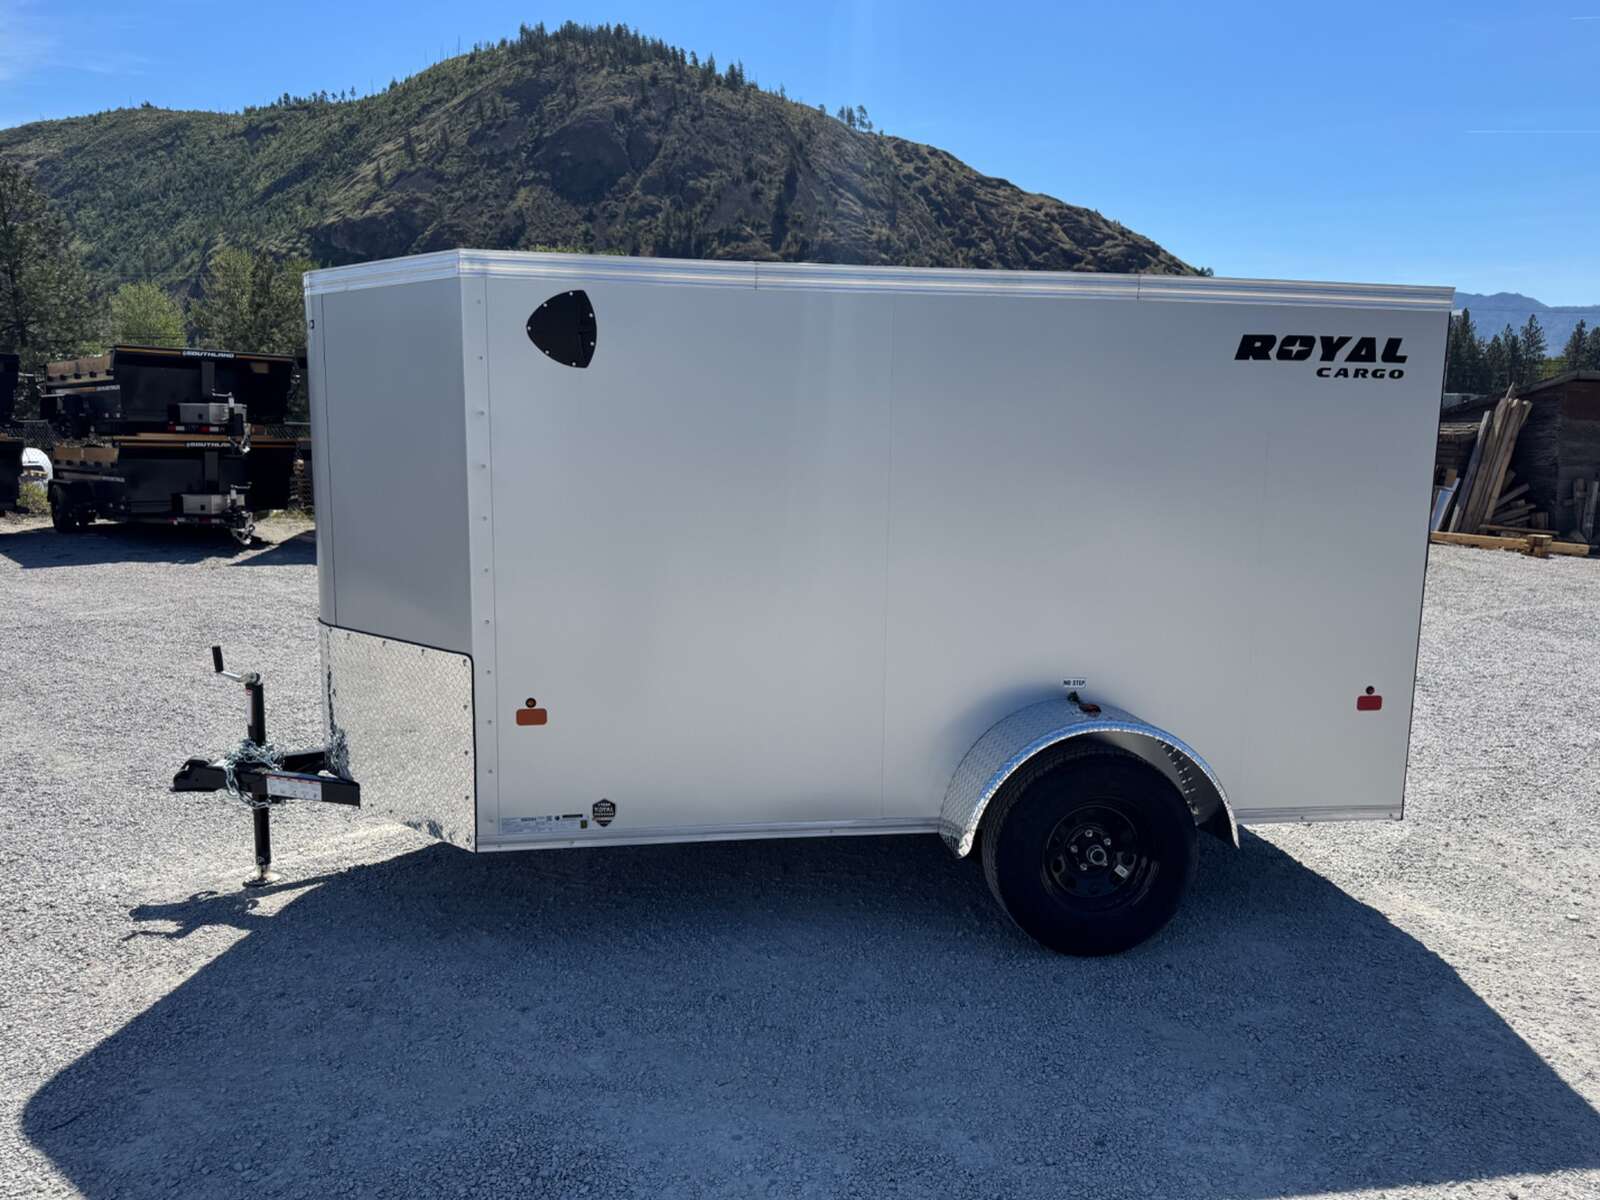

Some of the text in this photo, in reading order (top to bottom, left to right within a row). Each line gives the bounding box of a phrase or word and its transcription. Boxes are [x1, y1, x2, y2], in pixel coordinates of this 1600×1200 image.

[186, 351, 235, 359] SOUTHLAND
[1234, 334, 1409, 364] ROYAL
[1316, 367, 1405, 379] CARGO
